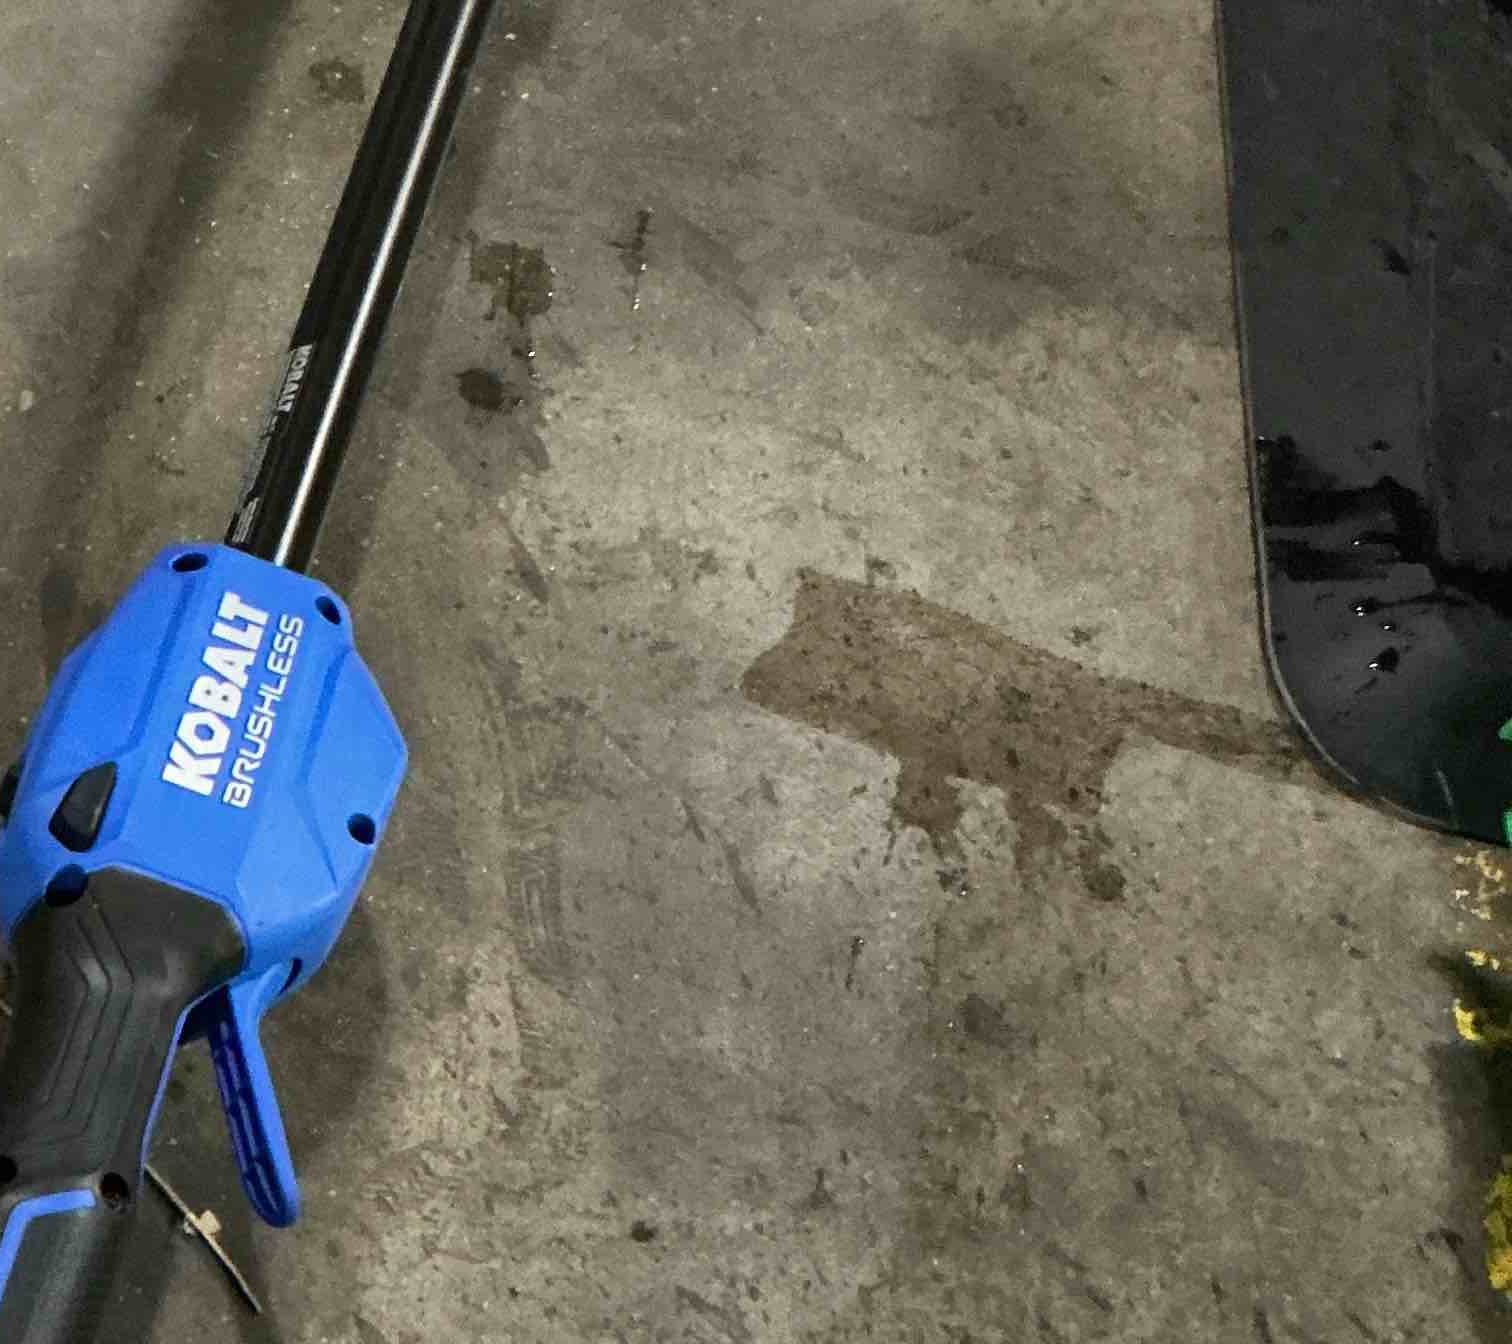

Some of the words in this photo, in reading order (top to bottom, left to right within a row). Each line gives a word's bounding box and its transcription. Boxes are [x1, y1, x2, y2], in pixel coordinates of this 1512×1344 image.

[276, 343, 313, 414] KOBALT
[162, 591, 269, 796] KOBALT
[223, 615, 304, 809] BRUSHLESS
